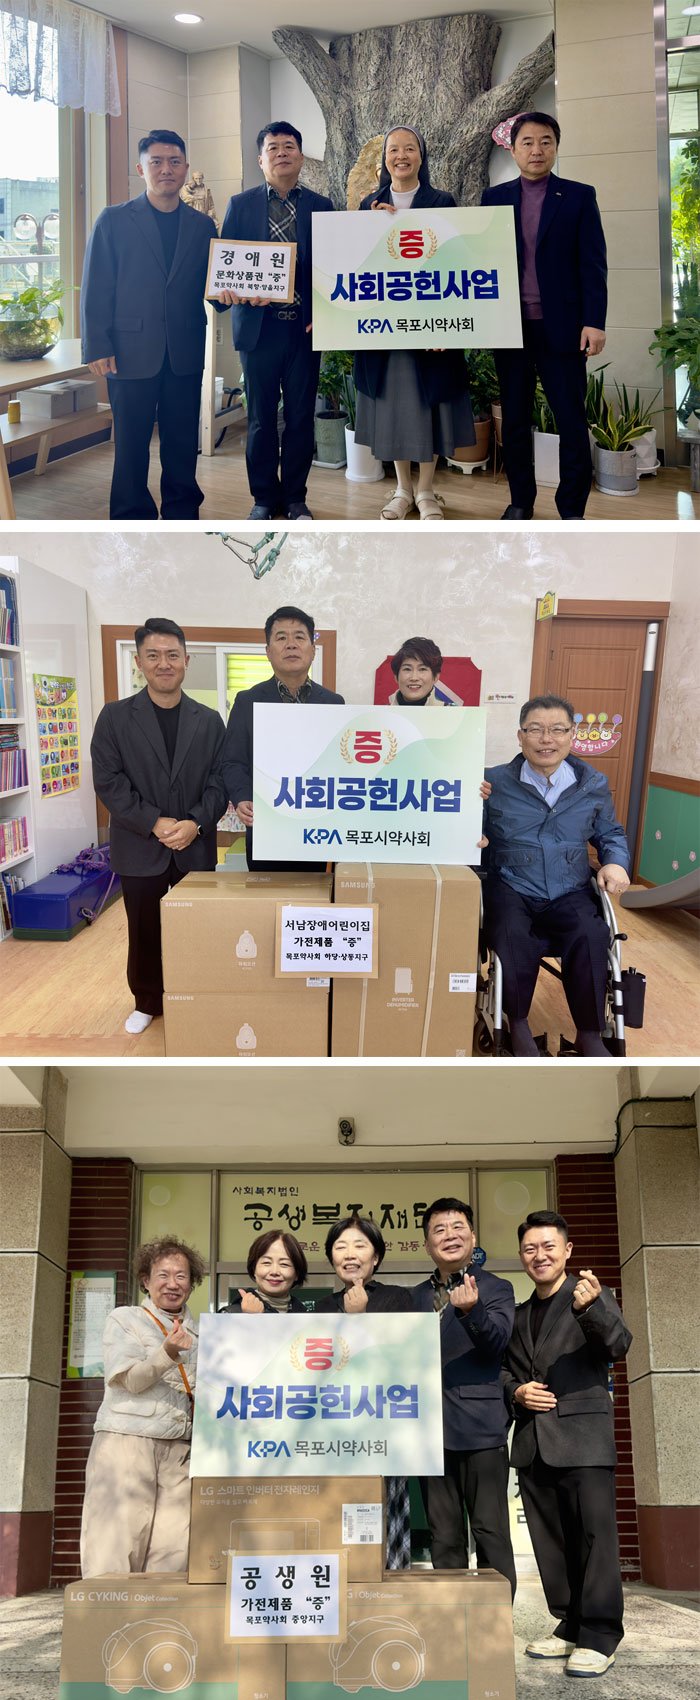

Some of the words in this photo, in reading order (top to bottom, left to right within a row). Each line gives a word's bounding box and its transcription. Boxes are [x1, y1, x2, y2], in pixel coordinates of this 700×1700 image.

[399, 230, 424, 258] 증
[220, 250, 235, 265] 경
[245, 252, 260, 267] 애
[270, 252, 285, 268] 원
[216, 270, 263, 281] 문화상품권
[214, 282, 244, 290] 목포약사회
[330, 270, 499, 302] 사회공헌사업
[396, 318, 474, 332] 목포시약사회
[354, 730, 382, 764] 증
[574, 740, 608, 752] 환영합니다
[274, 776, 462, 813] 사회공헌사업
[346, 830, 431, 847] 목포시약사회
[285, 920, 370, 931] 서남장애어린이집
[294, 937, 333, 947] 가전제품
[232, 1186, 299, 1196] 사회복지법인
[397, 1240, 420, 1252] 감동
[304, 1338, 334, 1371] 증
[216, 1384, 419, 1420] 사회공헌사업
[294, 1440, 388, 1457] 목포시약사회
[200, 1486, 214, 1496] LG
[216, 1486, 244, 1495] 스마트
[246, 1485, 273, 1495] 인버터
[274, 1485, 320, 1495] 전자레인지
[240, 1567, 261, 1590] 공
[275, 1565, 296, 1589] 생
[311, 1565, 330, 1588] 원
[70, 1592, 84, 1601] LG
[88, 1591, 128, 1602] CYKING
[134, 1594, 155, 1603] Objet
[359, 1592, 381, 1600] Objet
[241, 1597, 293, 1611] 가전제품
[245, 1616, 287, 1624] 목포약사회
[292, 1615, 324, 1624] 중앙지구
